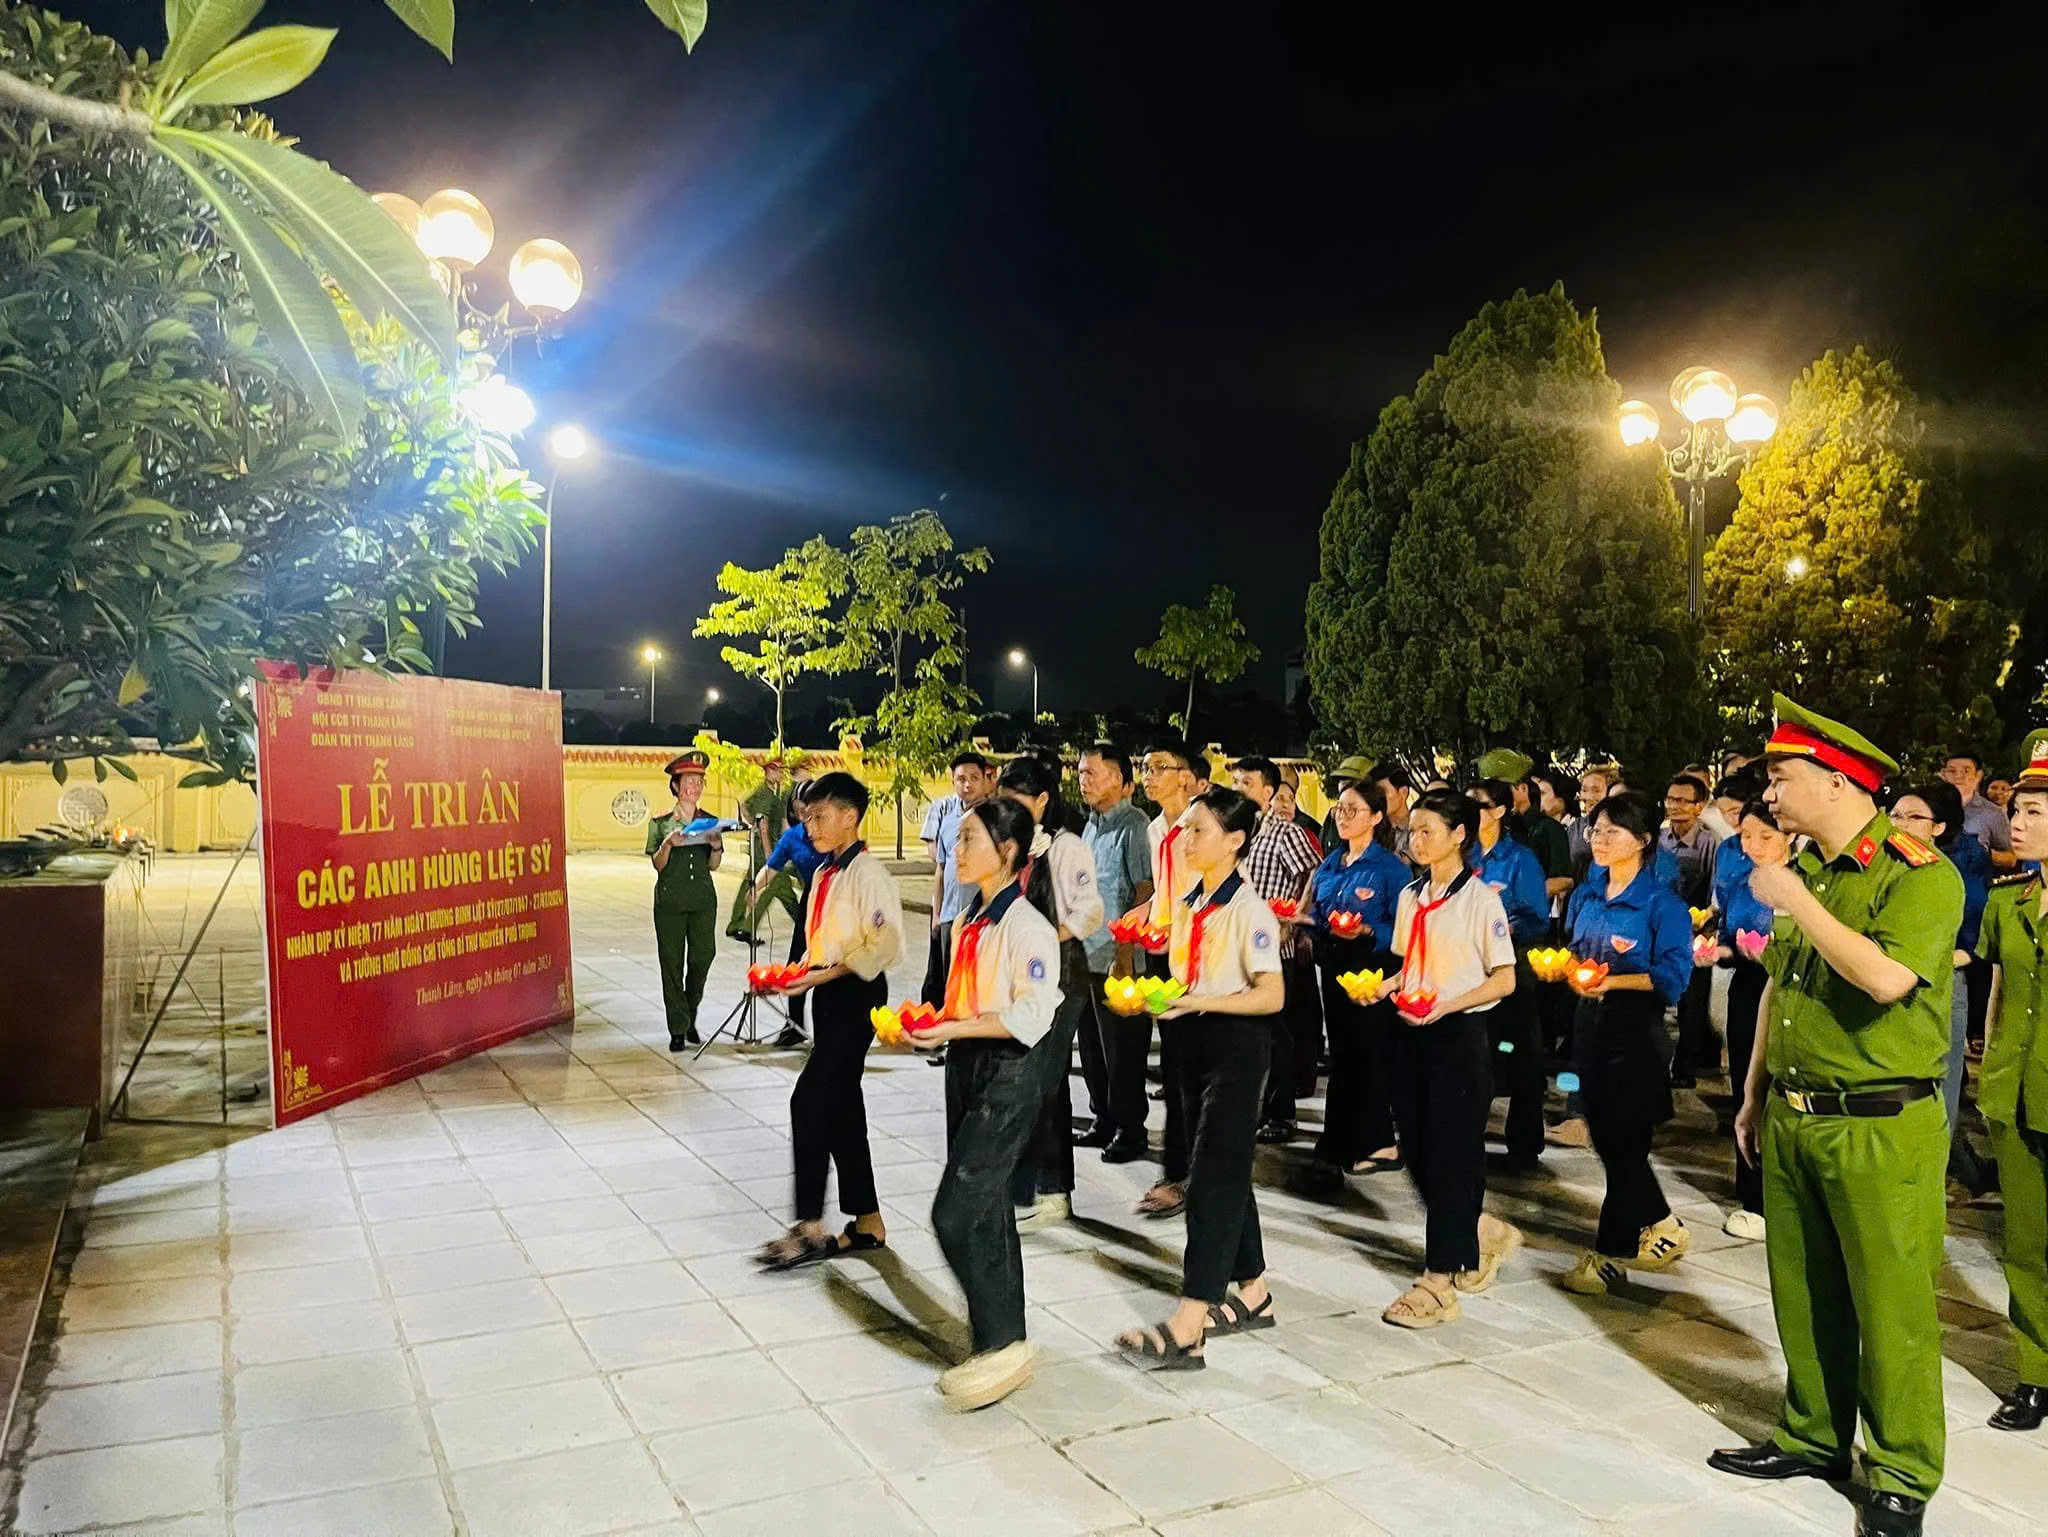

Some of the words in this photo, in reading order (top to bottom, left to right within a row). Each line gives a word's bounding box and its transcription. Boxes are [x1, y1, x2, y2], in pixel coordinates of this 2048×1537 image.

[336, 757, 395, 836] LỄ
[404, 781, 469, 829] TRI
[477, 767, 520, 824] ÂN
[297, 858, 355, 909] CÁC
[364, 856, 417, 899] ANH
[423, 847, 482, 890] HÙNG
[488, 841, 525, 885] LIỆT
[286, 930, 315, 960] NHÂN
[316, 929, 332, 957] DỊP
[348, 920, 370, 949] NIỆM
[372, 921, 382, 943] 77
[384, 914, 403, 940] NĂM
[404, 910, 424, 936] NGÀY
[472, 898, 485, 924] LIỆT
[340, 956, 353, 984] VÀ
[423, 938, 436, 963] CHÍ
[457, 932, 464, 956] BÍ
[416, 983, 441, 1006] Thanh
[466, 973, 482, 995] ngày
[484, 969, 493, 988] 26
[494, 967, 512, 985] tháng
